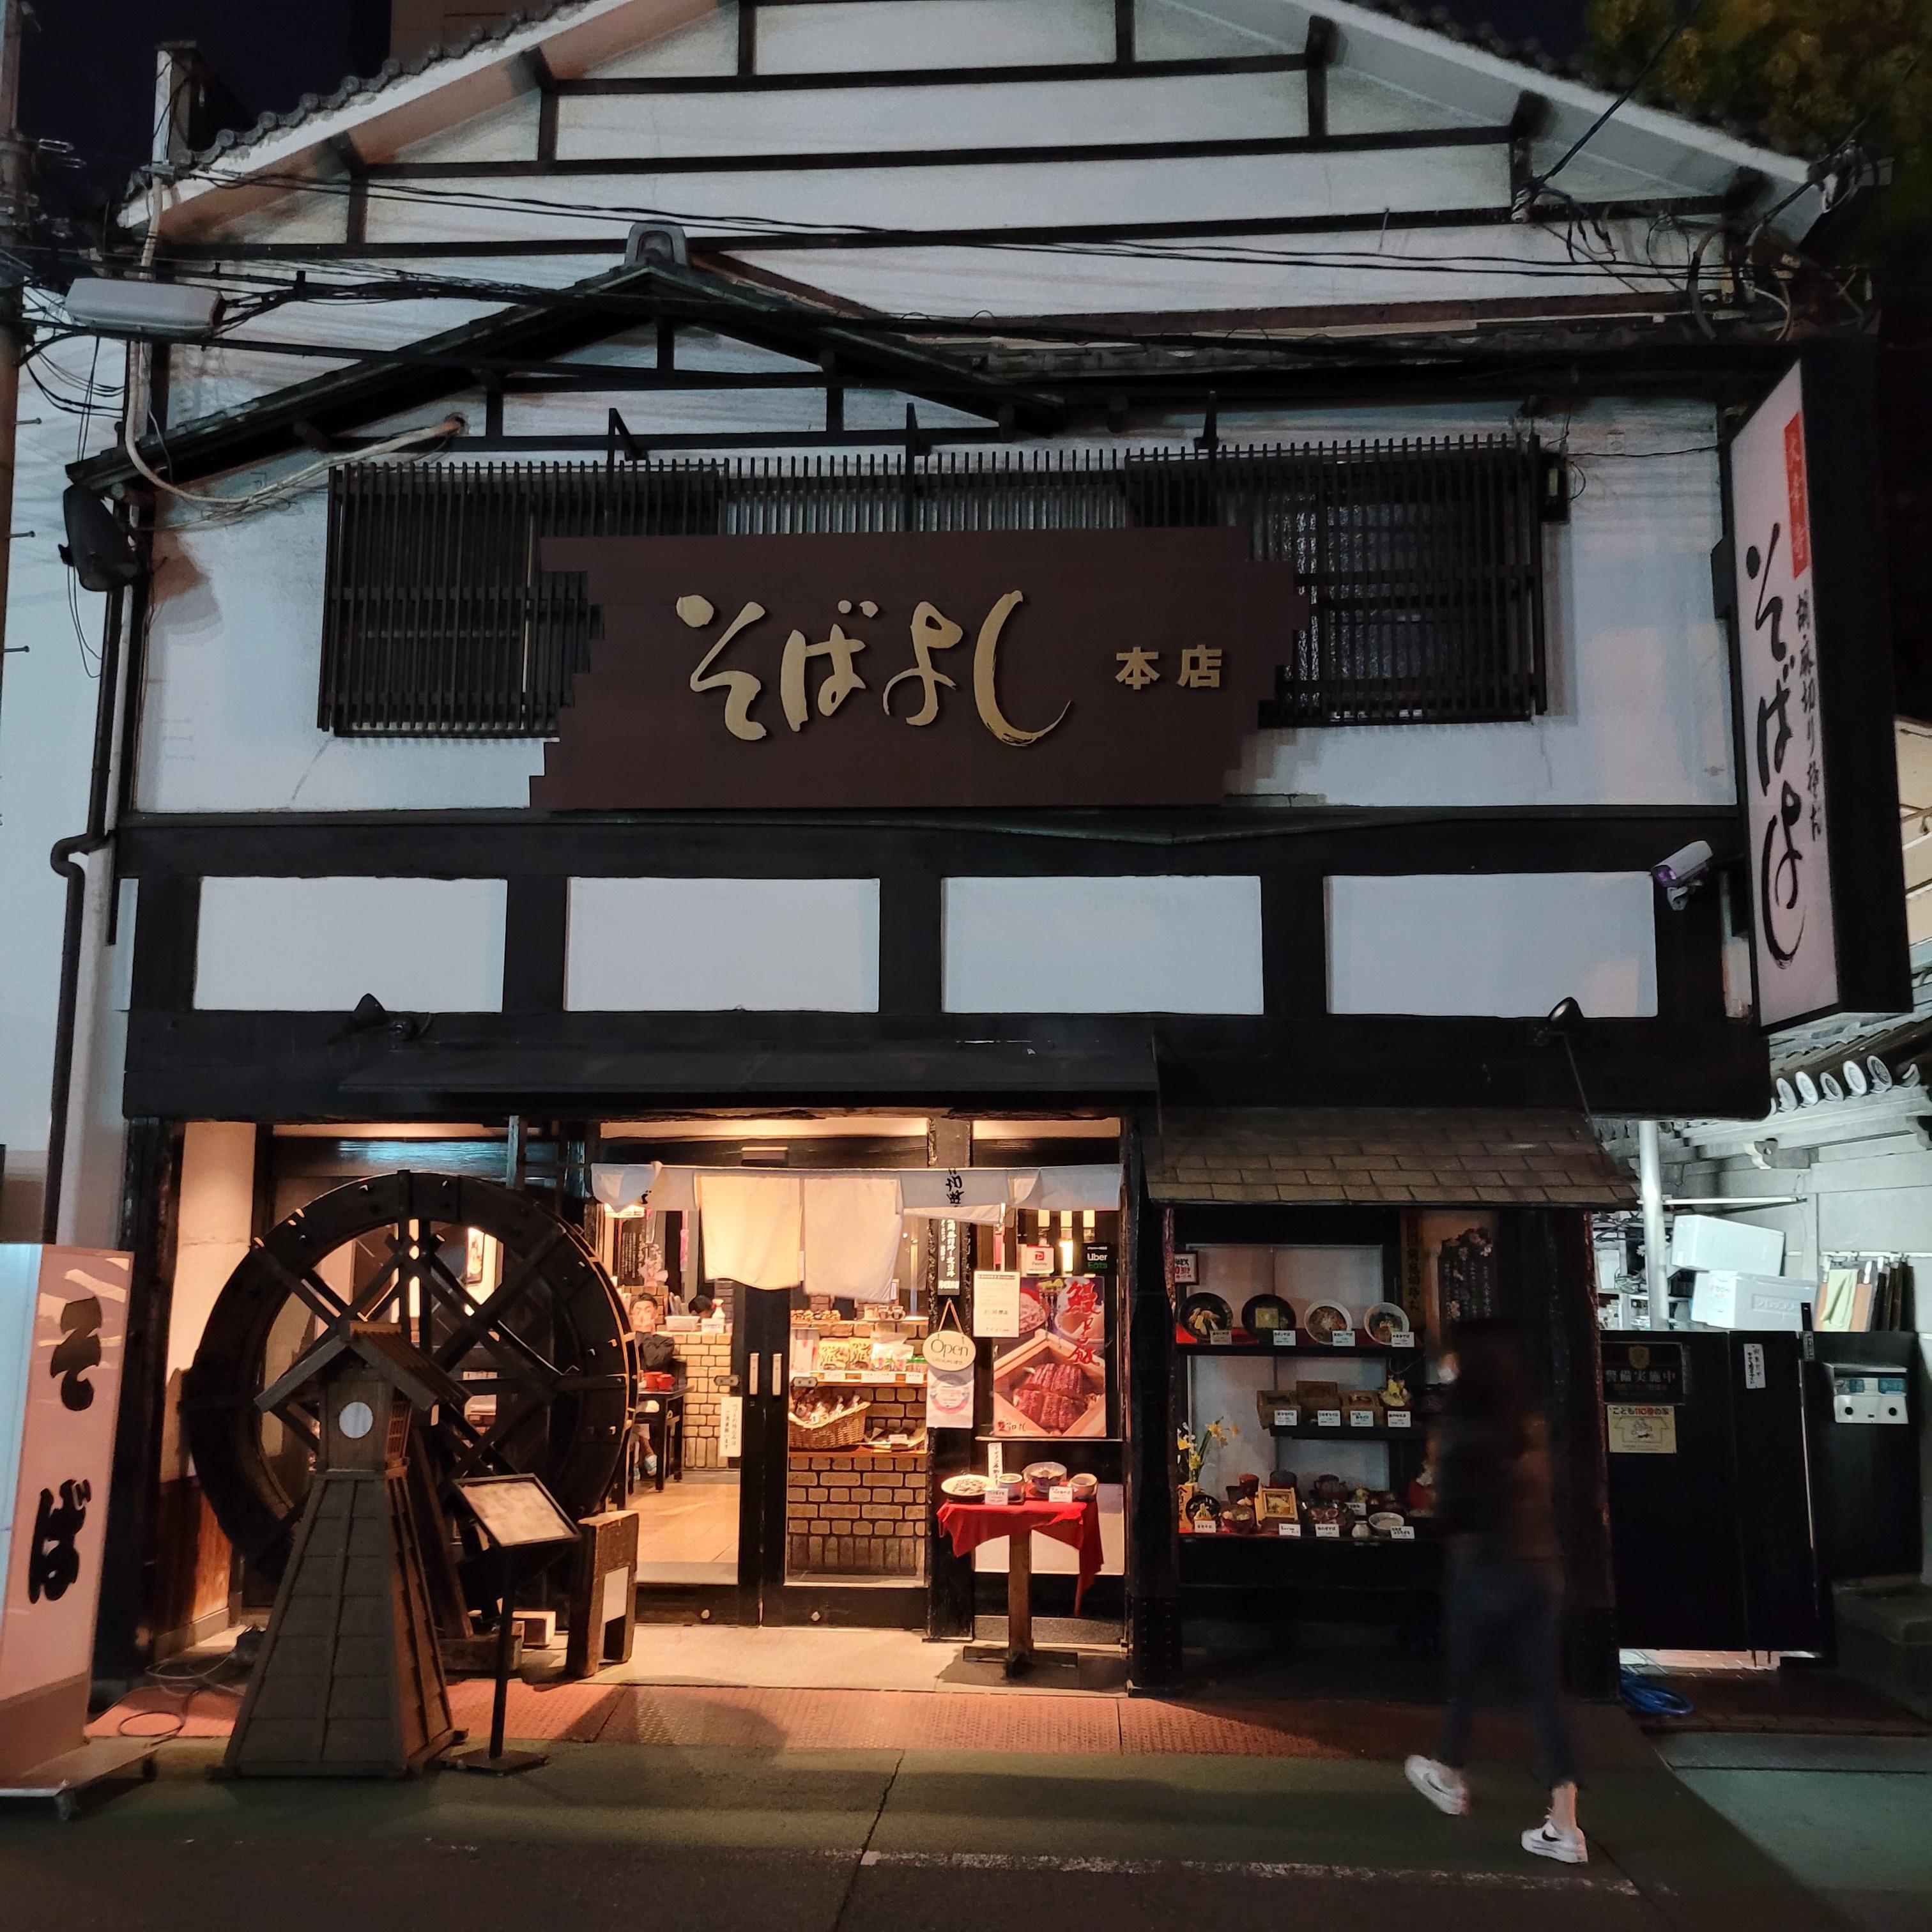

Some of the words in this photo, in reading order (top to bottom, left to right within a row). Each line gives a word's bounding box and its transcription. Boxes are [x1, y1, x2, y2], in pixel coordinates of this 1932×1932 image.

[675, 590, 1071, 747] そばよし
[1116, 644, 1223, 690] 本店
[1746, 523, 1806, 970] そばよし
[1087, 1253, 1108, 1261] Uber
[931, 1339, 969, 1358] Open
[29, 1295, 103, 1606] そば
